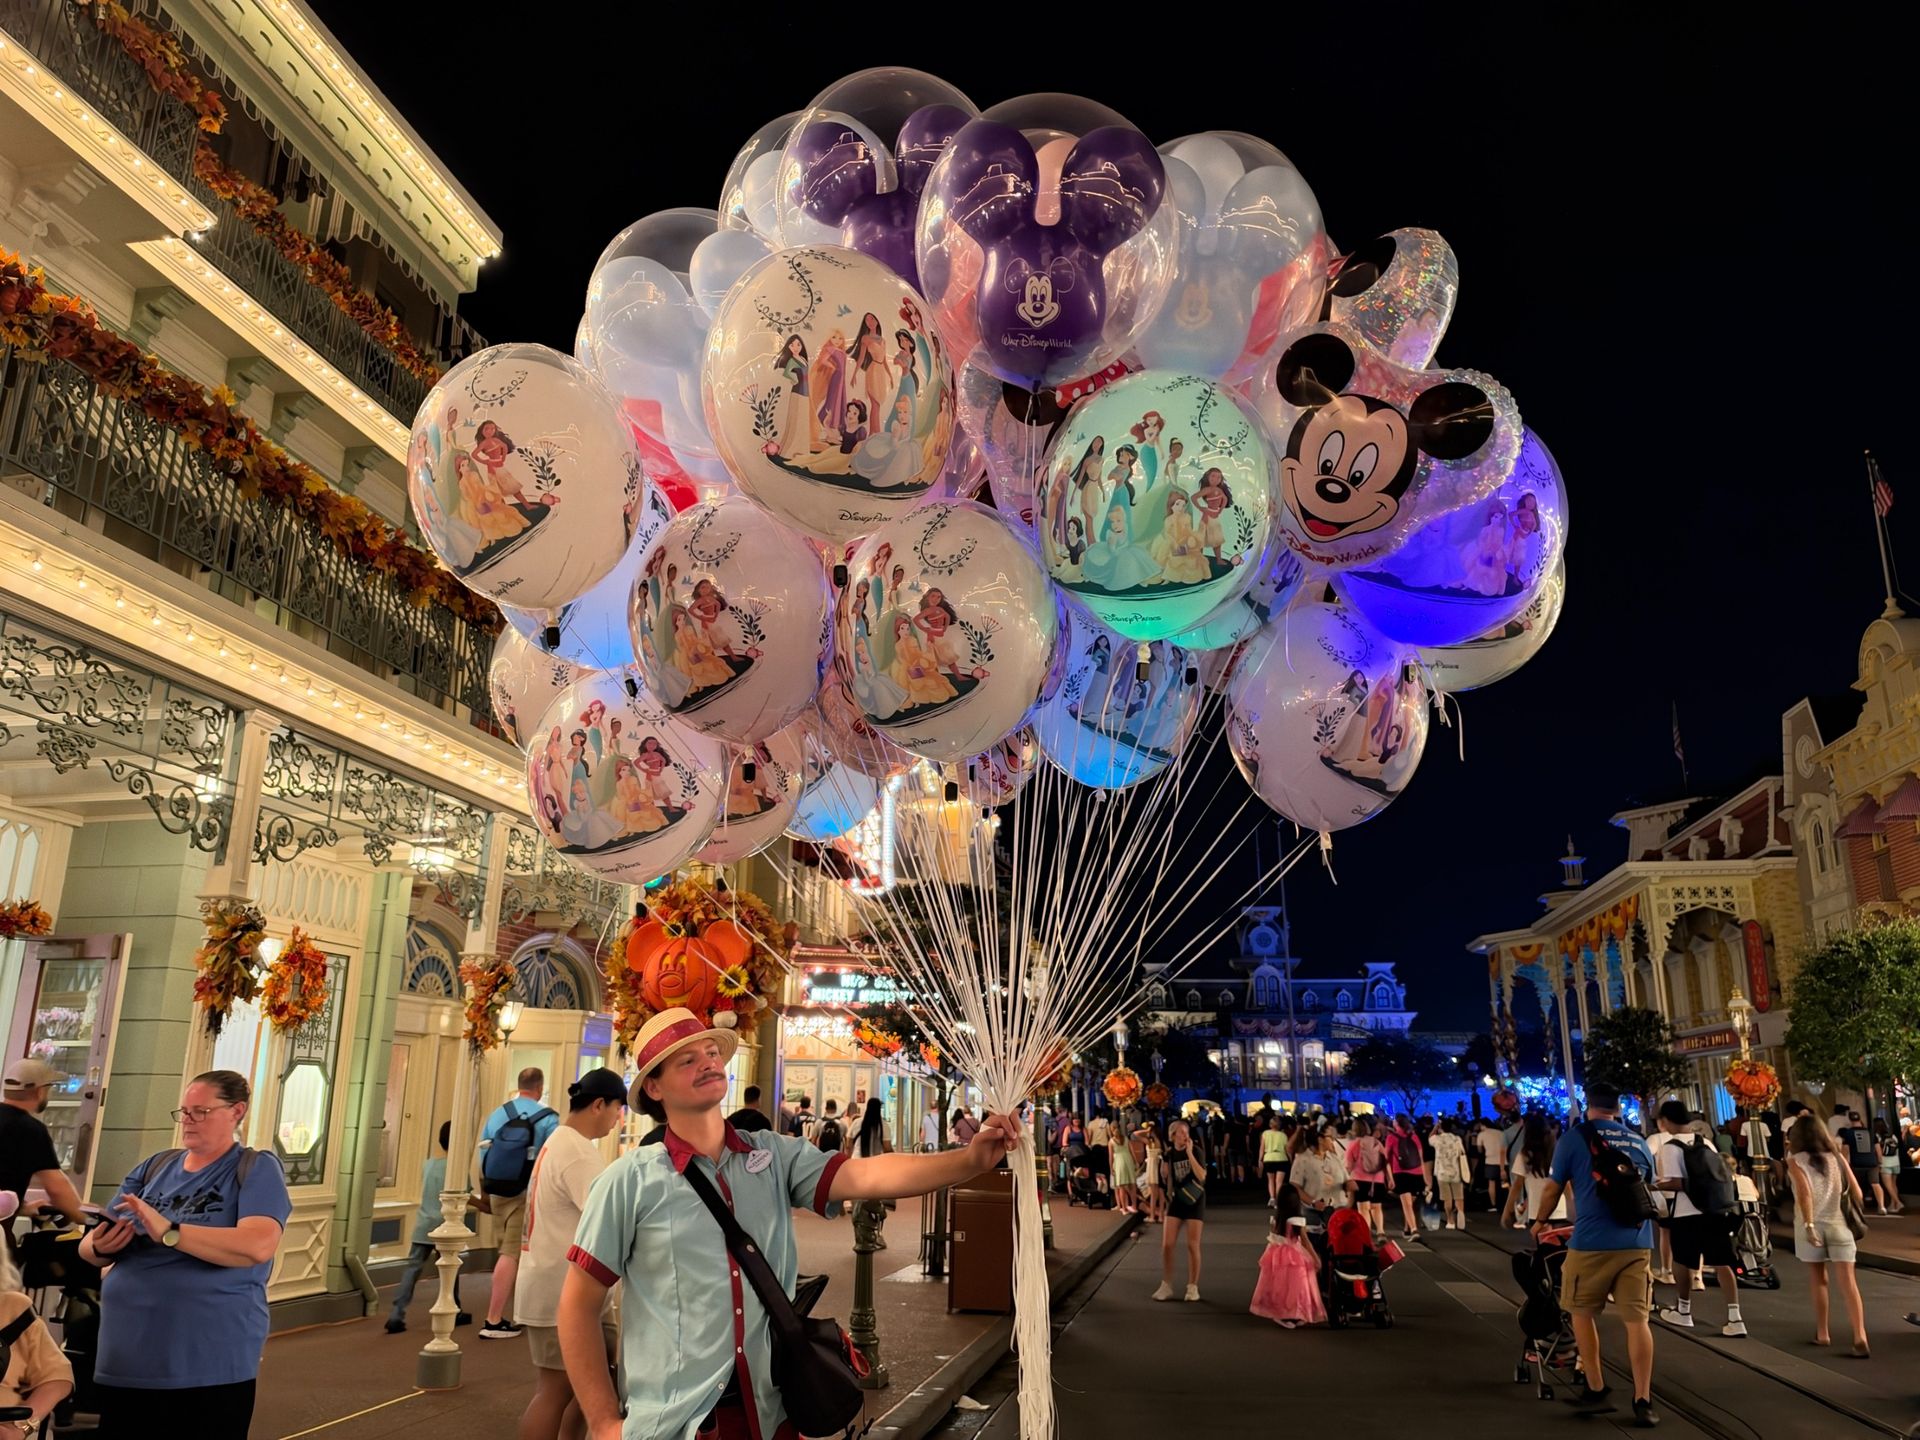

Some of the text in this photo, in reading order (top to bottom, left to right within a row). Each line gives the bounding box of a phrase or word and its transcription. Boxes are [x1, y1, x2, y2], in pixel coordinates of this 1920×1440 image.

[1002, 333, 1073, 351] Walt Disney World
[838, 509, 872, 524] Disney
[1284, 528, 1383, 566] Disney World
[1098, 612, 1162, 625] Disney Parks
[810, 987, 855, 1002] MICKEY
